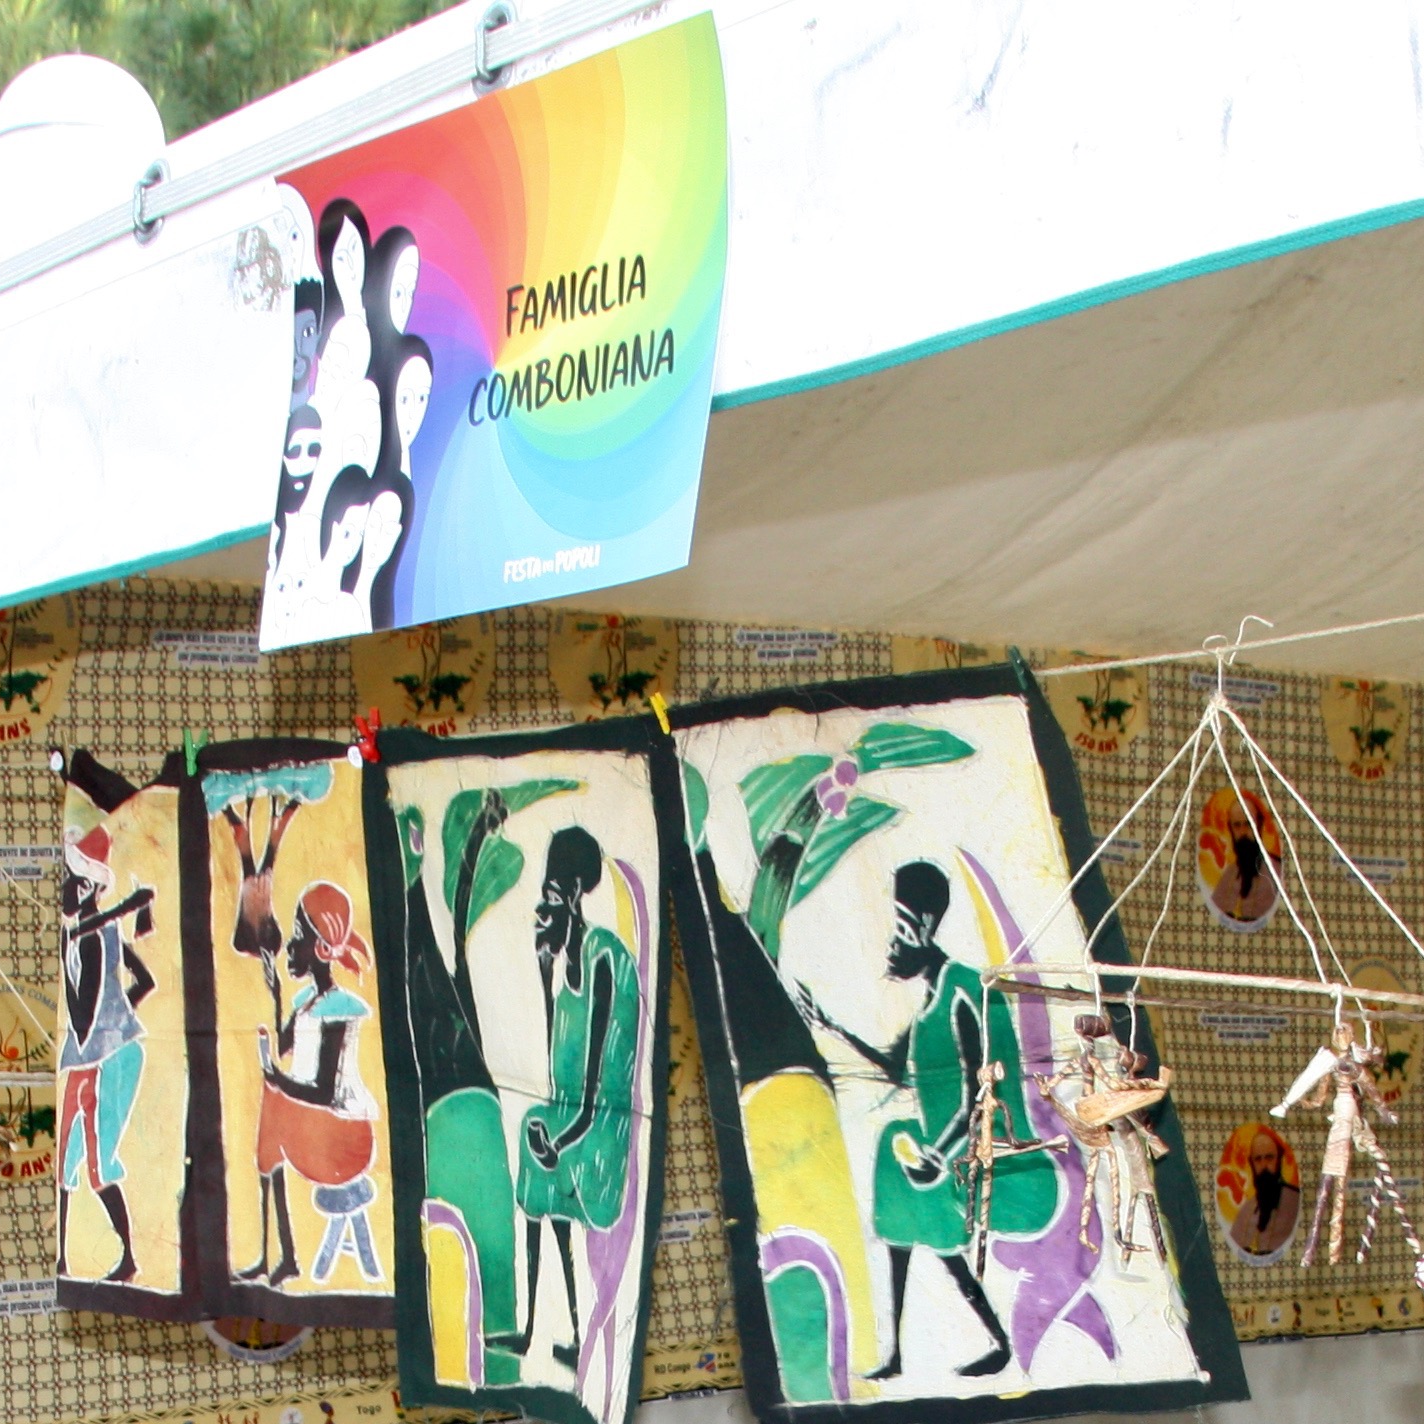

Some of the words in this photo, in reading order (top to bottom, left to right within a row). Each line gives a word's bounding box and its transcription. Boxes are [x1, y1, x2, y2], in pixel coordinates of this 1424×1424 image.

[506, 254, 646, 338] FAMIGLIA
[468, 328, 674, 427] COMBONIANA
[503, 556, 541, 584] FESTA
[555, 543, 601, 575] POPOLI
